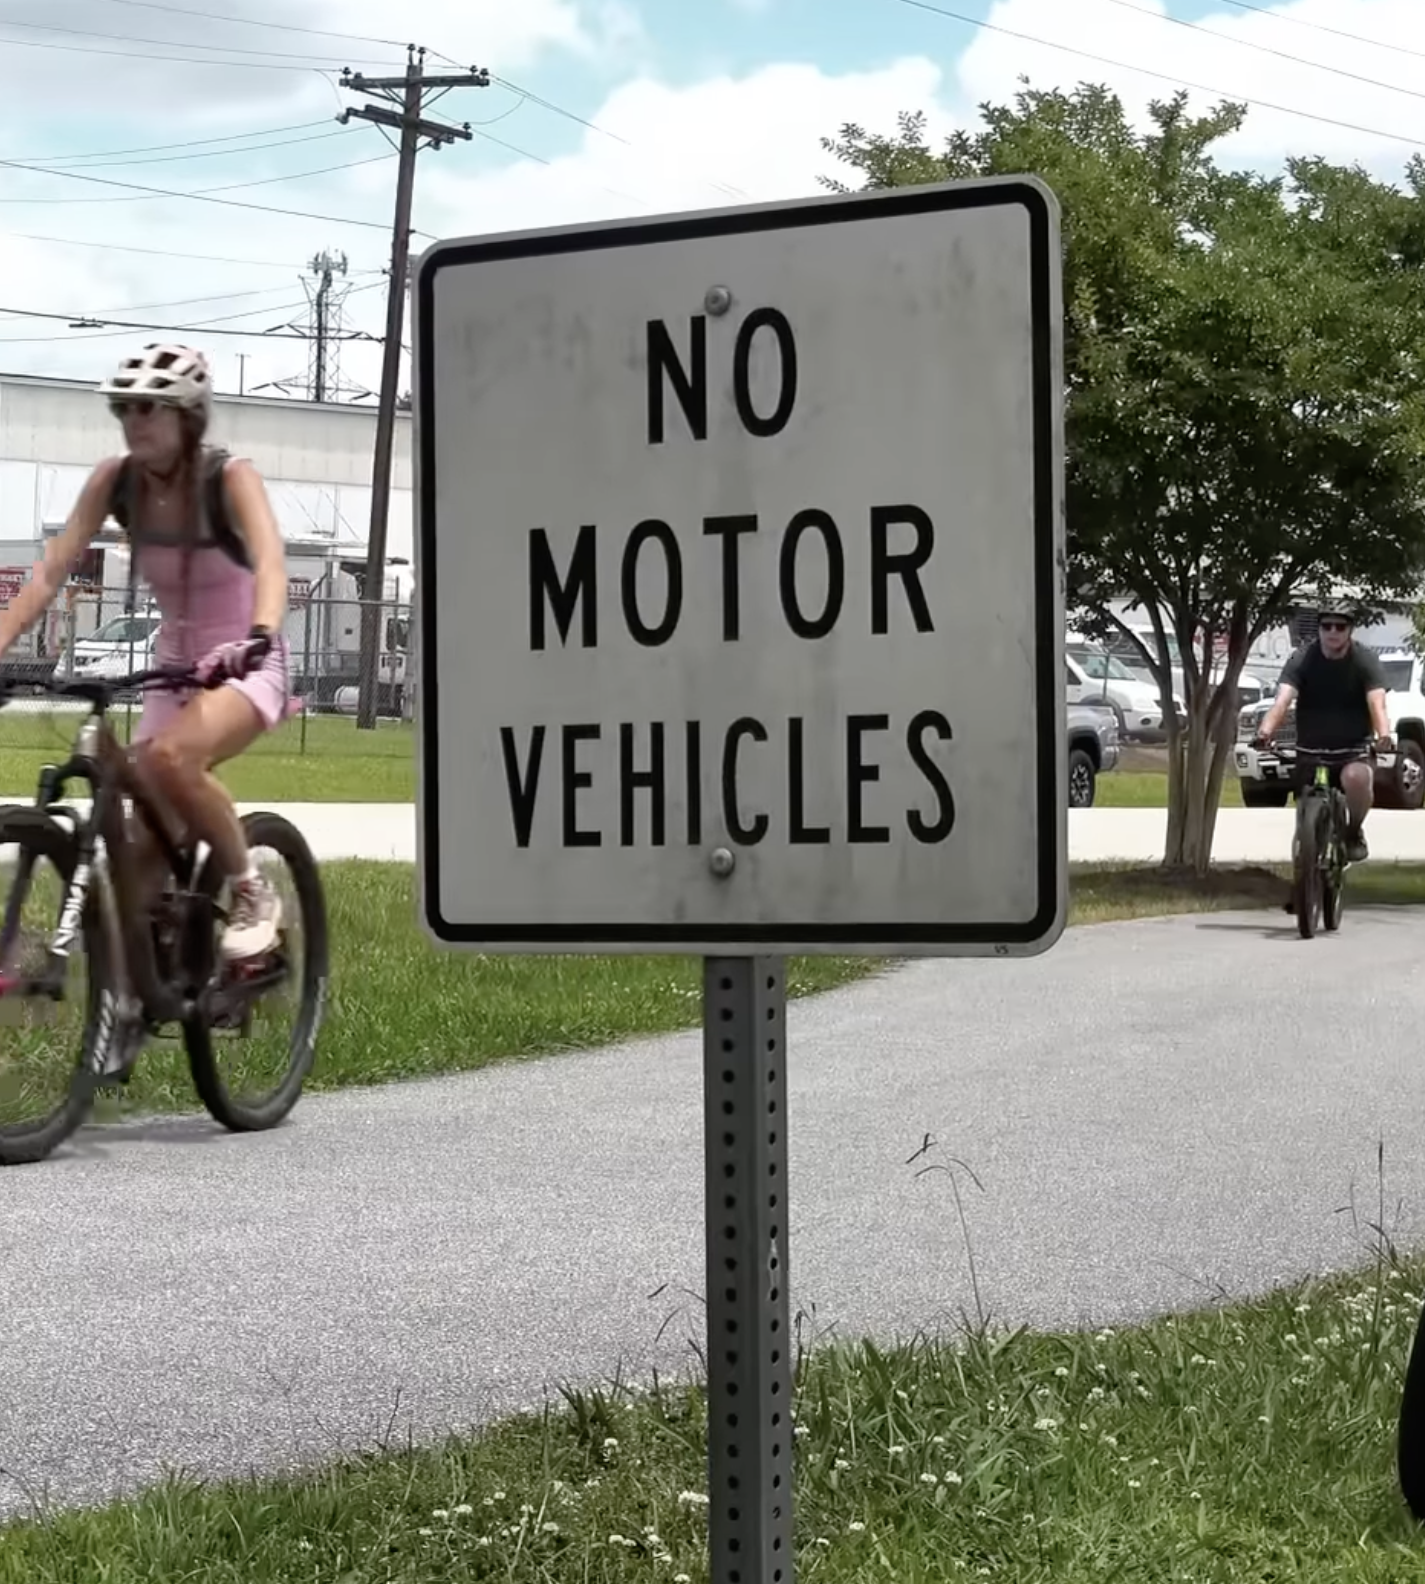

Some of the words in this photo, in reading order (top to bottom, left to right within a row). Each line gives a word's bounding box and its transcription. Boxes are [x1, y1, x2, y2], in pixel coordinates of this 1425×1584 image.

[645, 306, 798, 445] NO
[528, 503, 935, 652] MOTOR
[499, 708, 956, 849] VEHICLES
